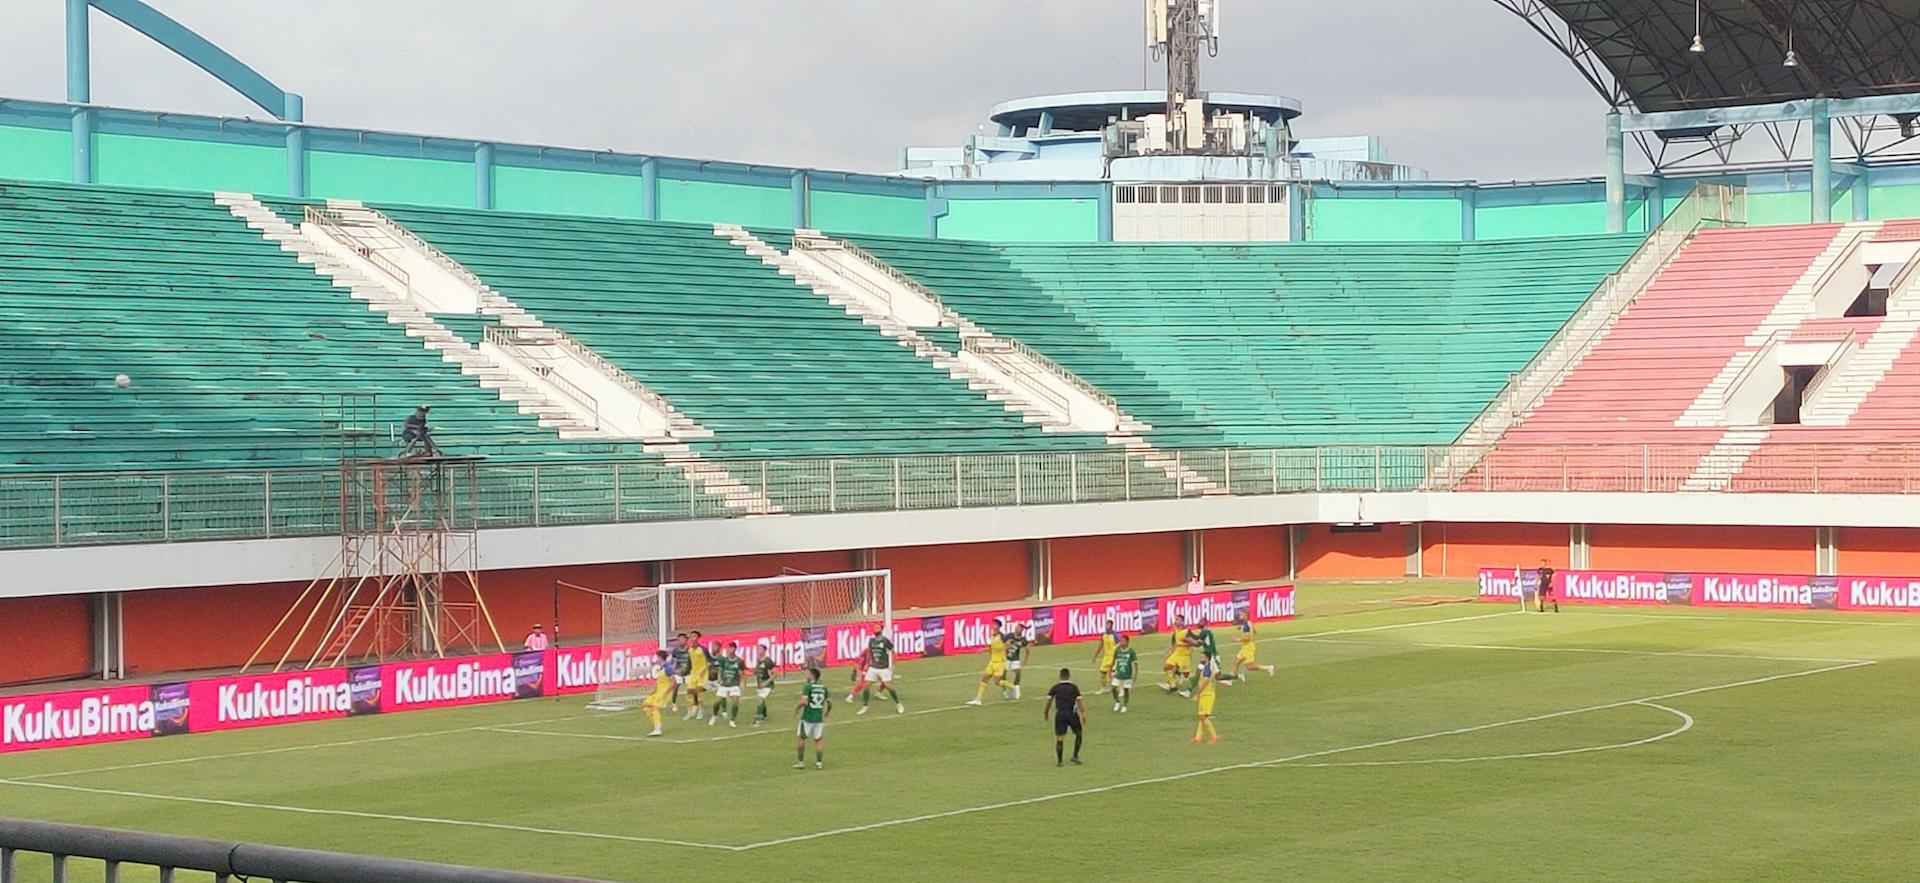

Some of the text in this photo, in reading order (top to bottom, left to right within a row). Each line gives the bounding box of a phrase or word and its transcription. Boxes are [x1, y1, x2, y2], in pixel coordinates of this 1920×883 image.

[1566, 573, 1667, 601] KukuBima
[1705, 577, 1813, 605] KukuBima
[218, 677, 351, 722] KukuBima
[396, 662, 516, 704] KukuBima
[810, 693, 825, 709] 32
[3, 695, 156, 744] KukuBima
